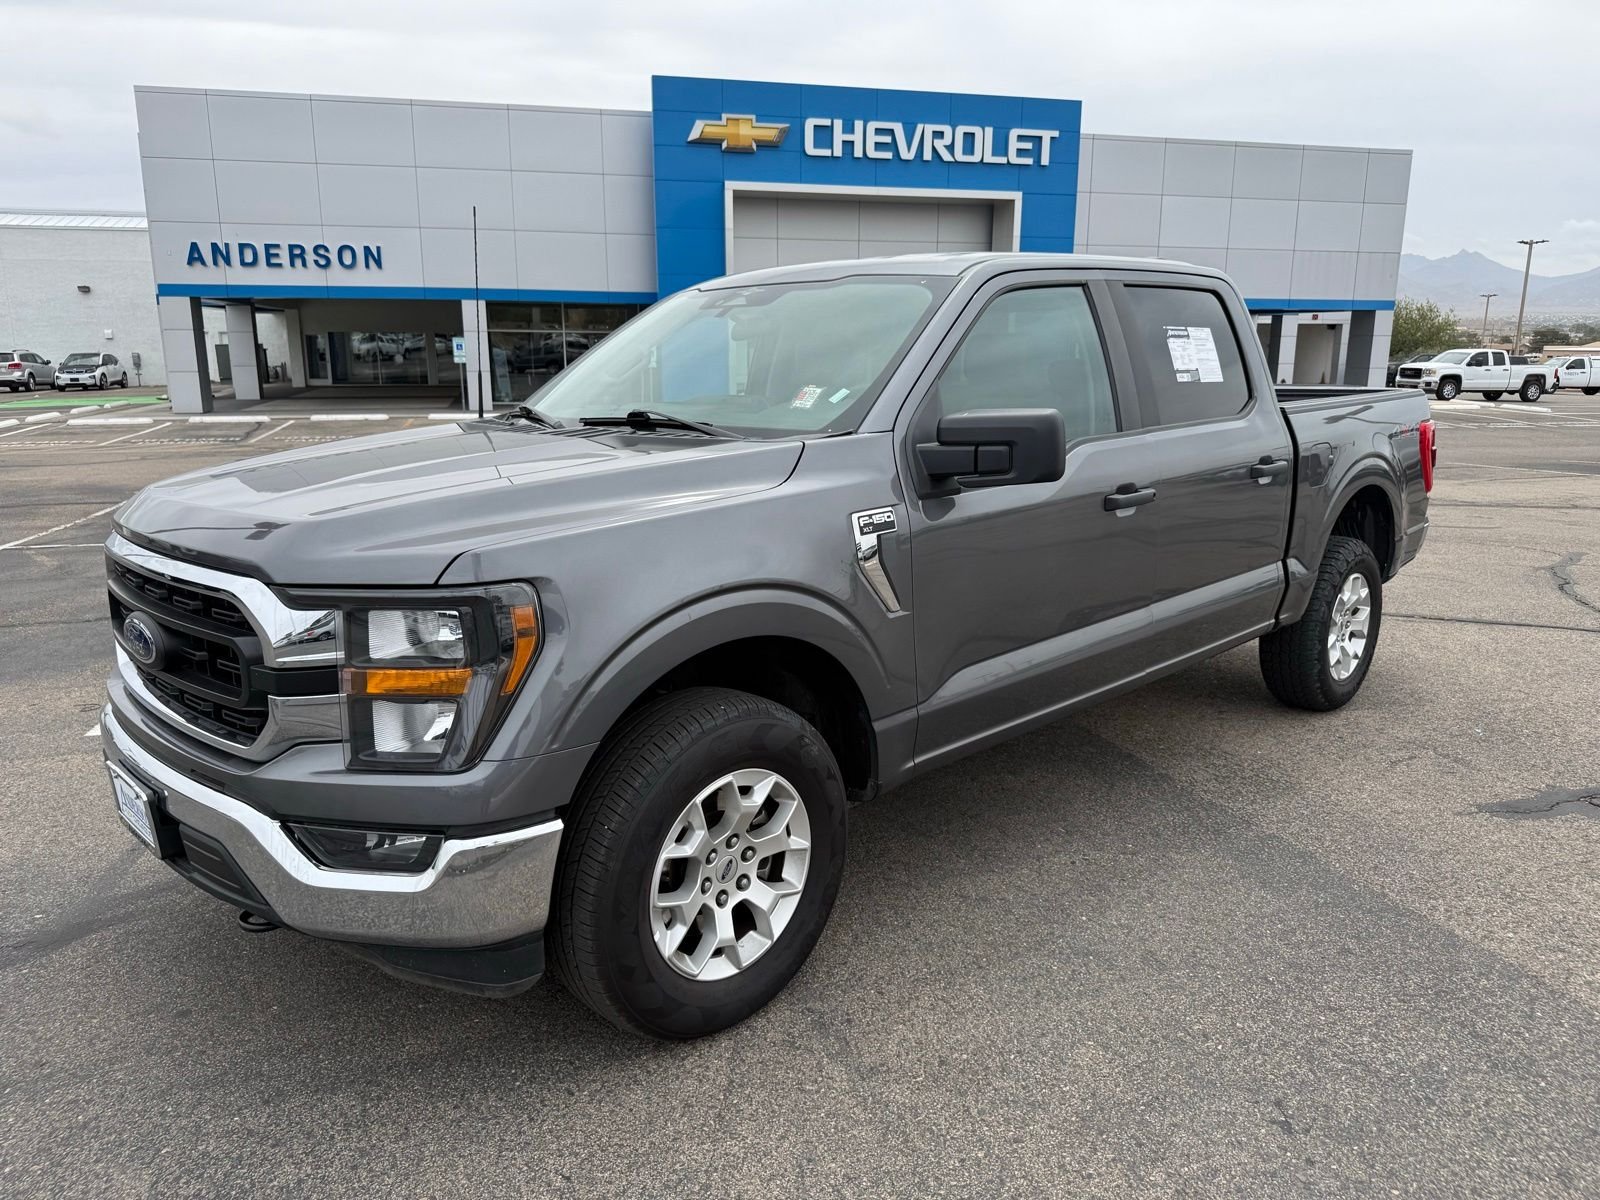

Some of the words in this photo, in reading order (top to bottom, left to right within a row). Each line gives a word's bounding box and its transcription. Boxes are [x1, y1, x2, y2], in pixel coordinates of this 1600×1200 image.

[804, 117, 1060, 167] CHEVROLET
[186, 241, 384, 270] ANDERSON
[859, 512, 894, 526] F-150
